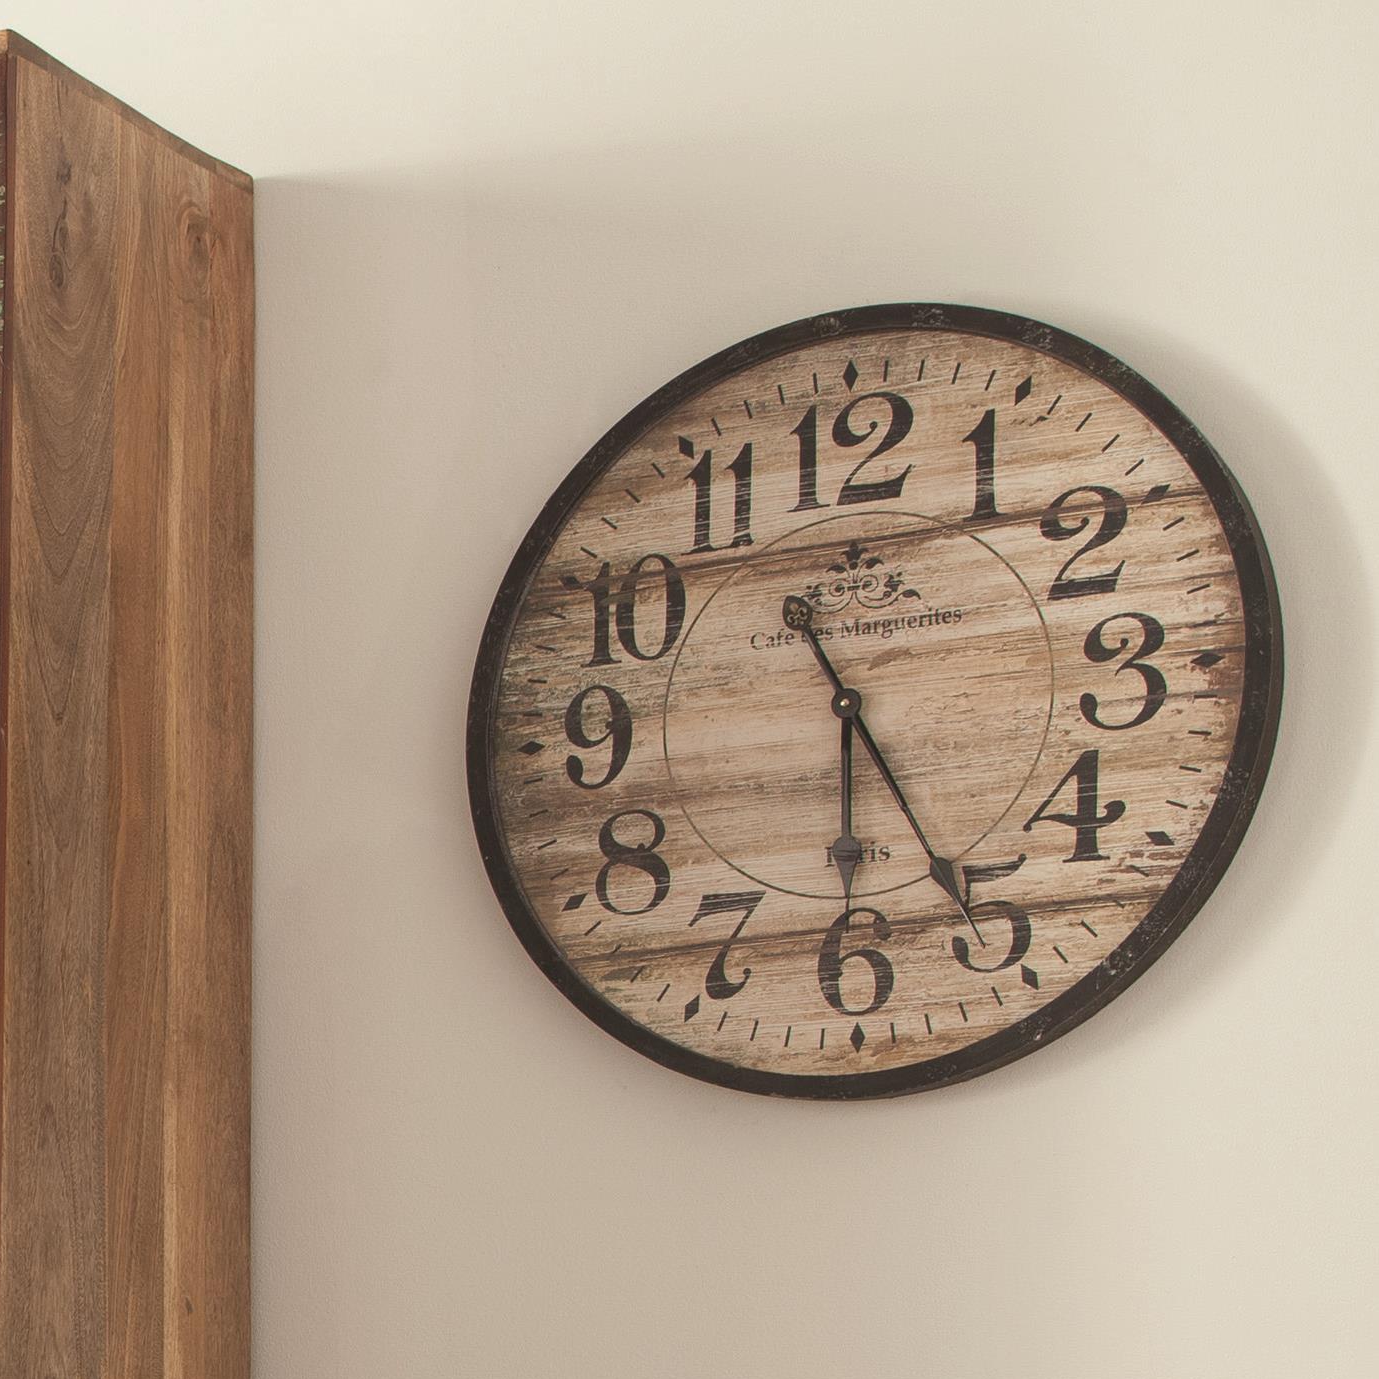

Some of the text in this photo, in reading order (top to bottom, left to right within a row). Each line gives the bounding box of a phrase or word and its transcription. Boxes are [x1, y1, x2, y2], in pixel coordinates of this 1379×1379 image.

[683, 441, 754, 555] 11
[787, 391, 915, 513] 12
[962, 409, 1006, 523] 1
[1039, 485, 1128, 601] 2
[579, 552, 687, 668] 10
[801, 621, 834, 643] es
[840, 608, 963, 639] Marguerites
[1080, 613, 1167, 731] 3
[565, 685, 633, 789] 9
[595, 809, 671, 914] 8
[824, 841, 890, 868] ris
[1024, 749, 1127, 864] 4
[688, 890, 767, 1000] 7
[818, 907, 894, 1016] 6
[952, 853, 1032, 972] 5
